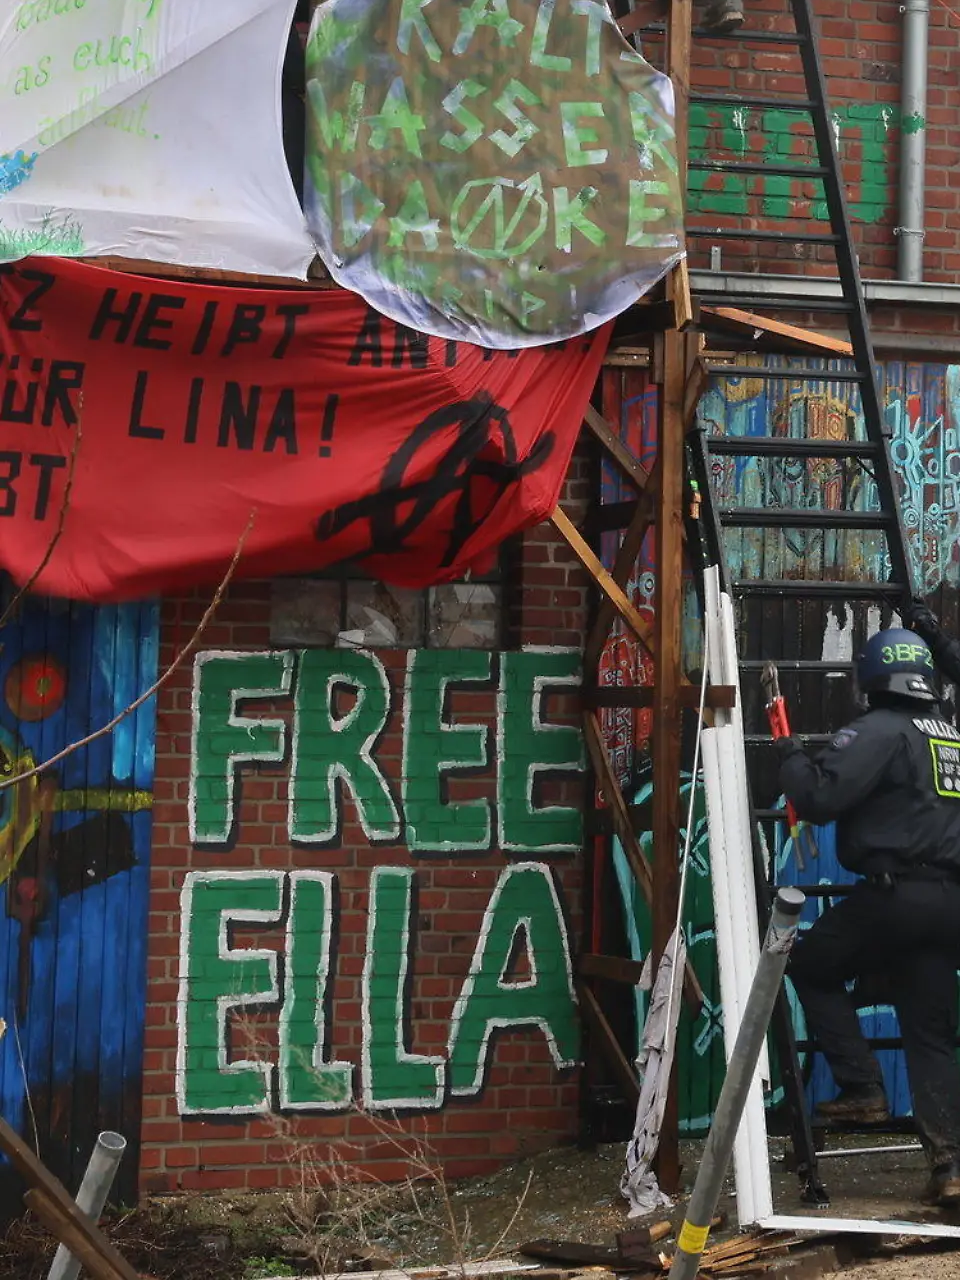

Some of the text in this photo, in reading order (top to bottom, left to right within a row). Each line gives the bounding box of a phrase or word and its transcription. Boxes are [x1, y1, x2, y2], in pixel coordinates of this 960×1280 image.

[73, 26, 151, 72] euch
[306, 75, 679, 176] WASSER
[0, 263, 55, 332] Z
[0, 353, 340, 458] ÜR LINA!
[187, 644, 585, 854] FREE
[177, 861, 585, 1116] ELLA
